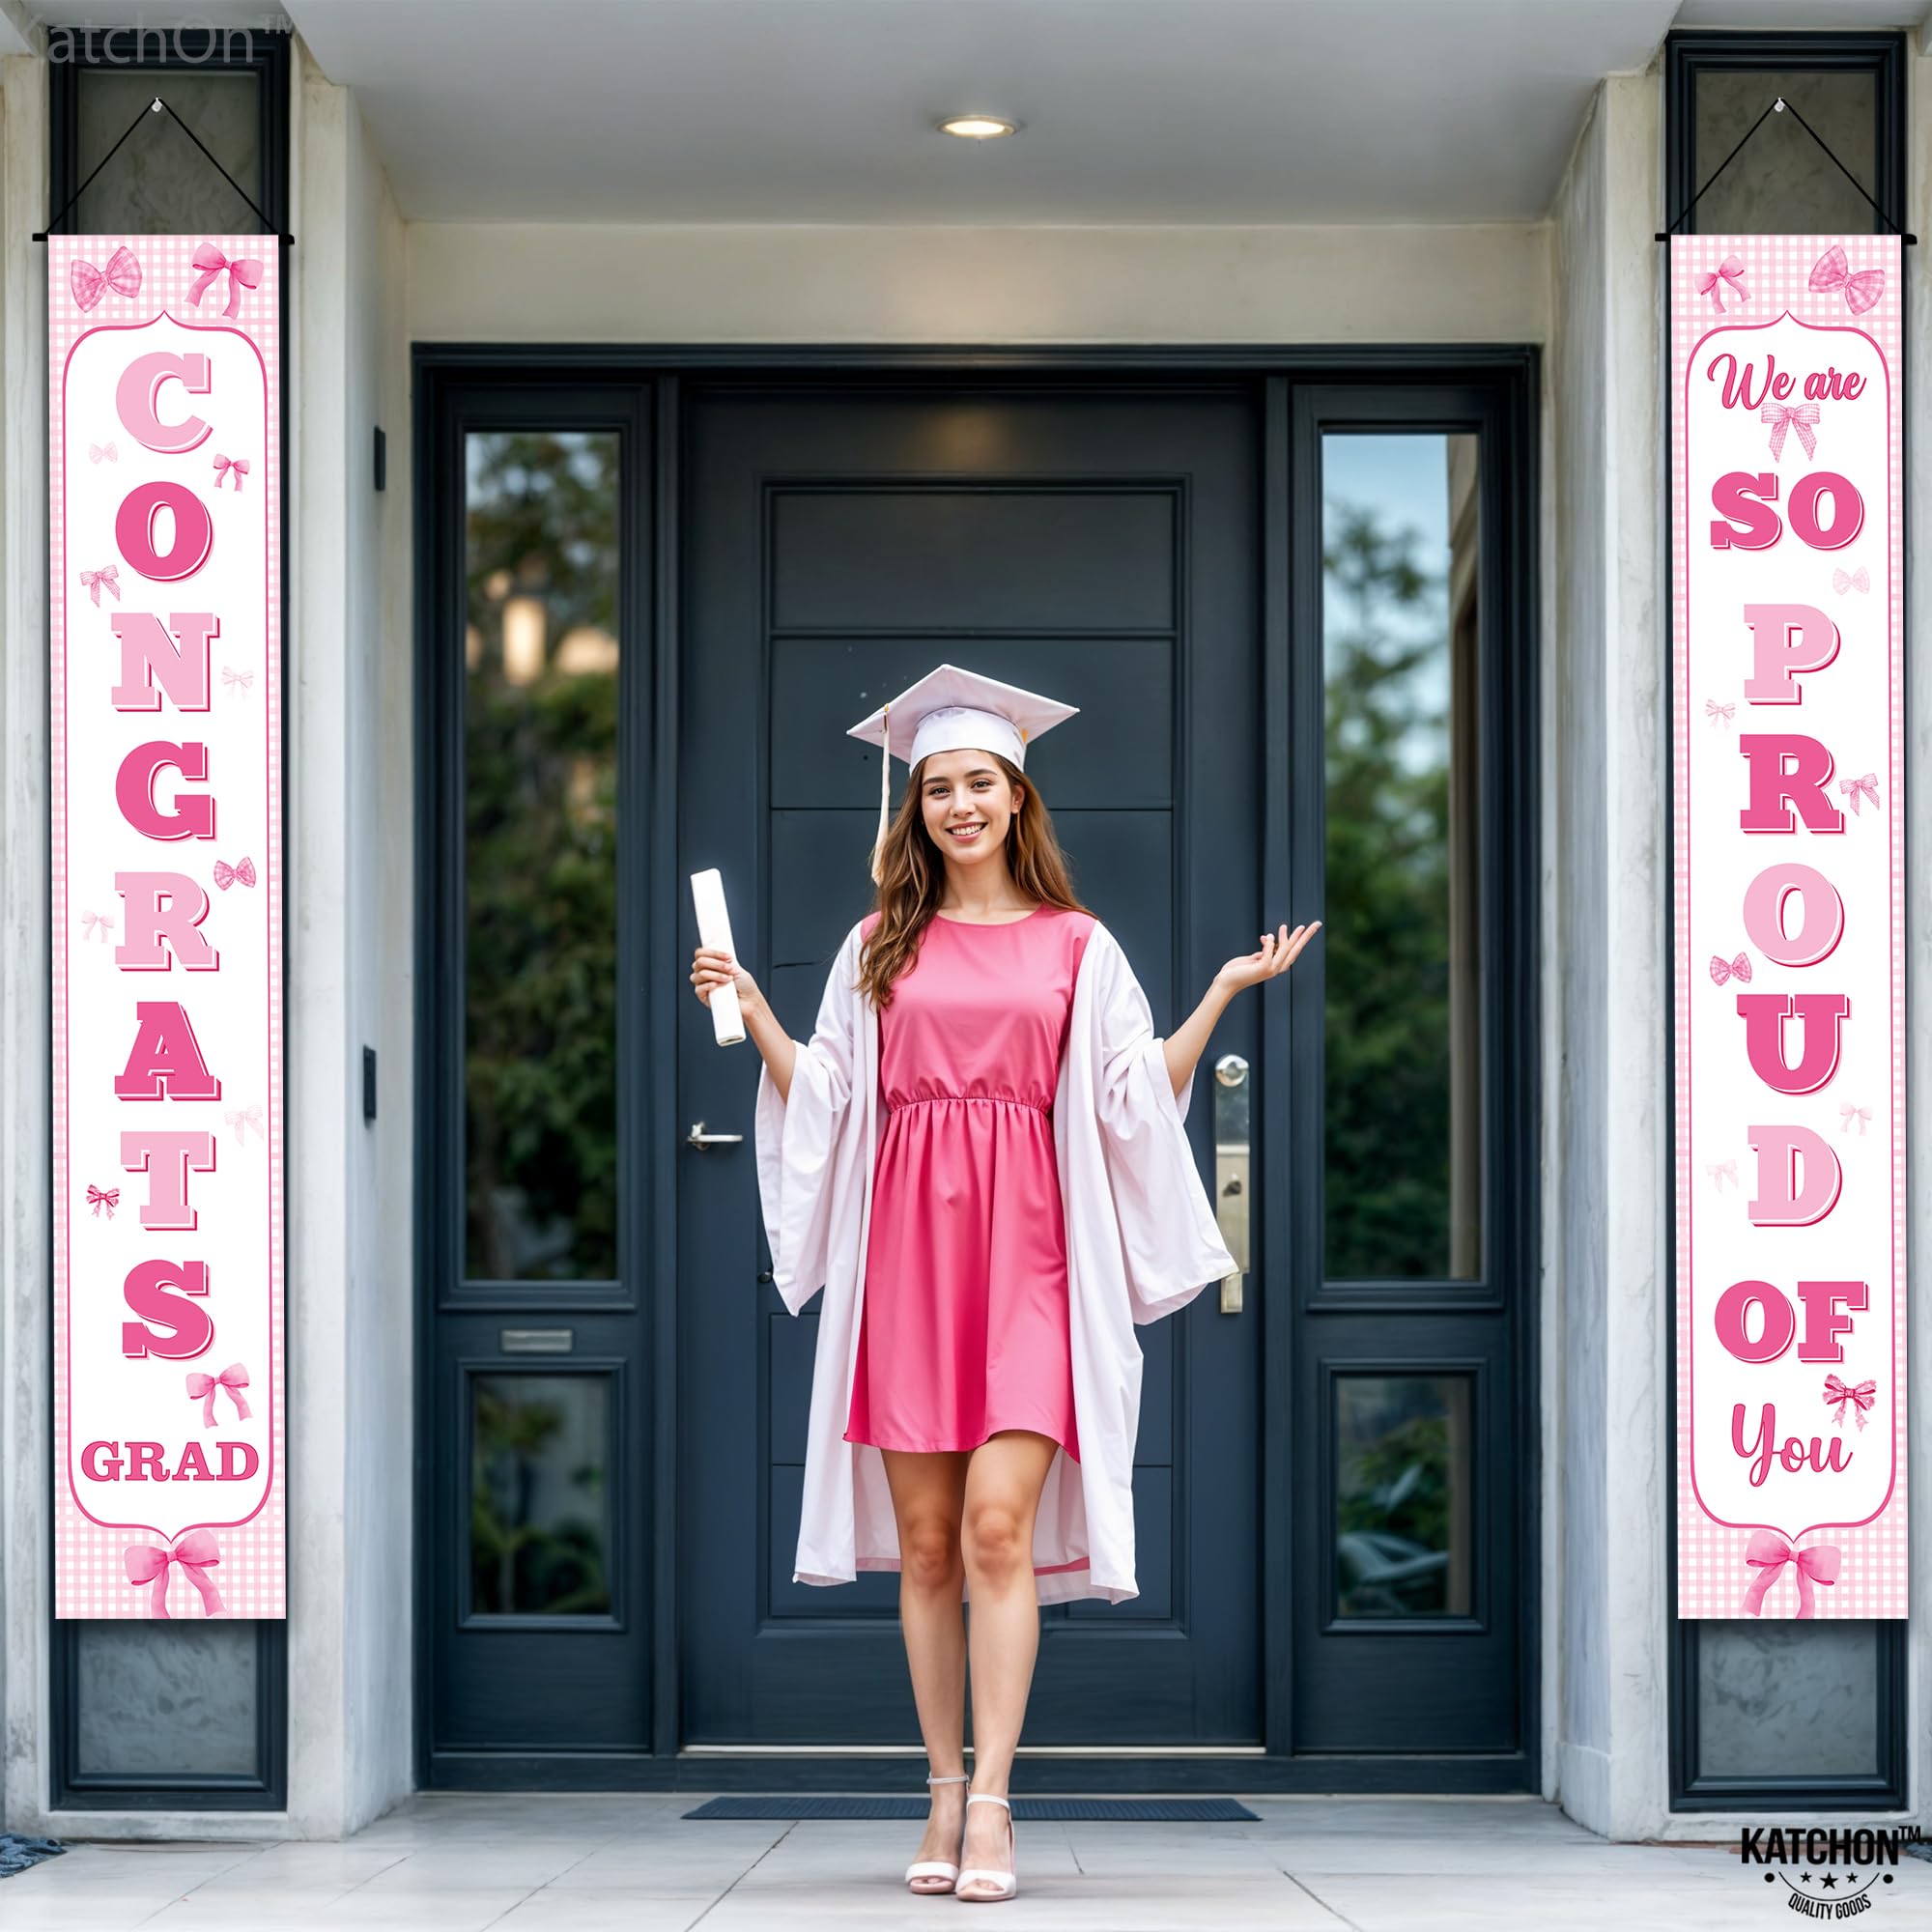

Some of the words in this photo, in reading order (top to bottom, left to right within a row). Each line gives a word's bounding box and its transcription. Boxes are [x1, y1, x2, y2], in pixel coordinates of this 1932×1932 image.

[1707, 353, 1796, 411] We
[1804, 366, 1867, 401] are
[1710, 471, 1865, 552] SO
[110, 352, 221, 1362] CONGRATS
[1736, 604, 1852, 1228] PROUD
[1714, 1280, 1870, 1365] OF
[80, 1440, 260, 1483] GRAD
[1731, 1403, 1854, 1488] You
